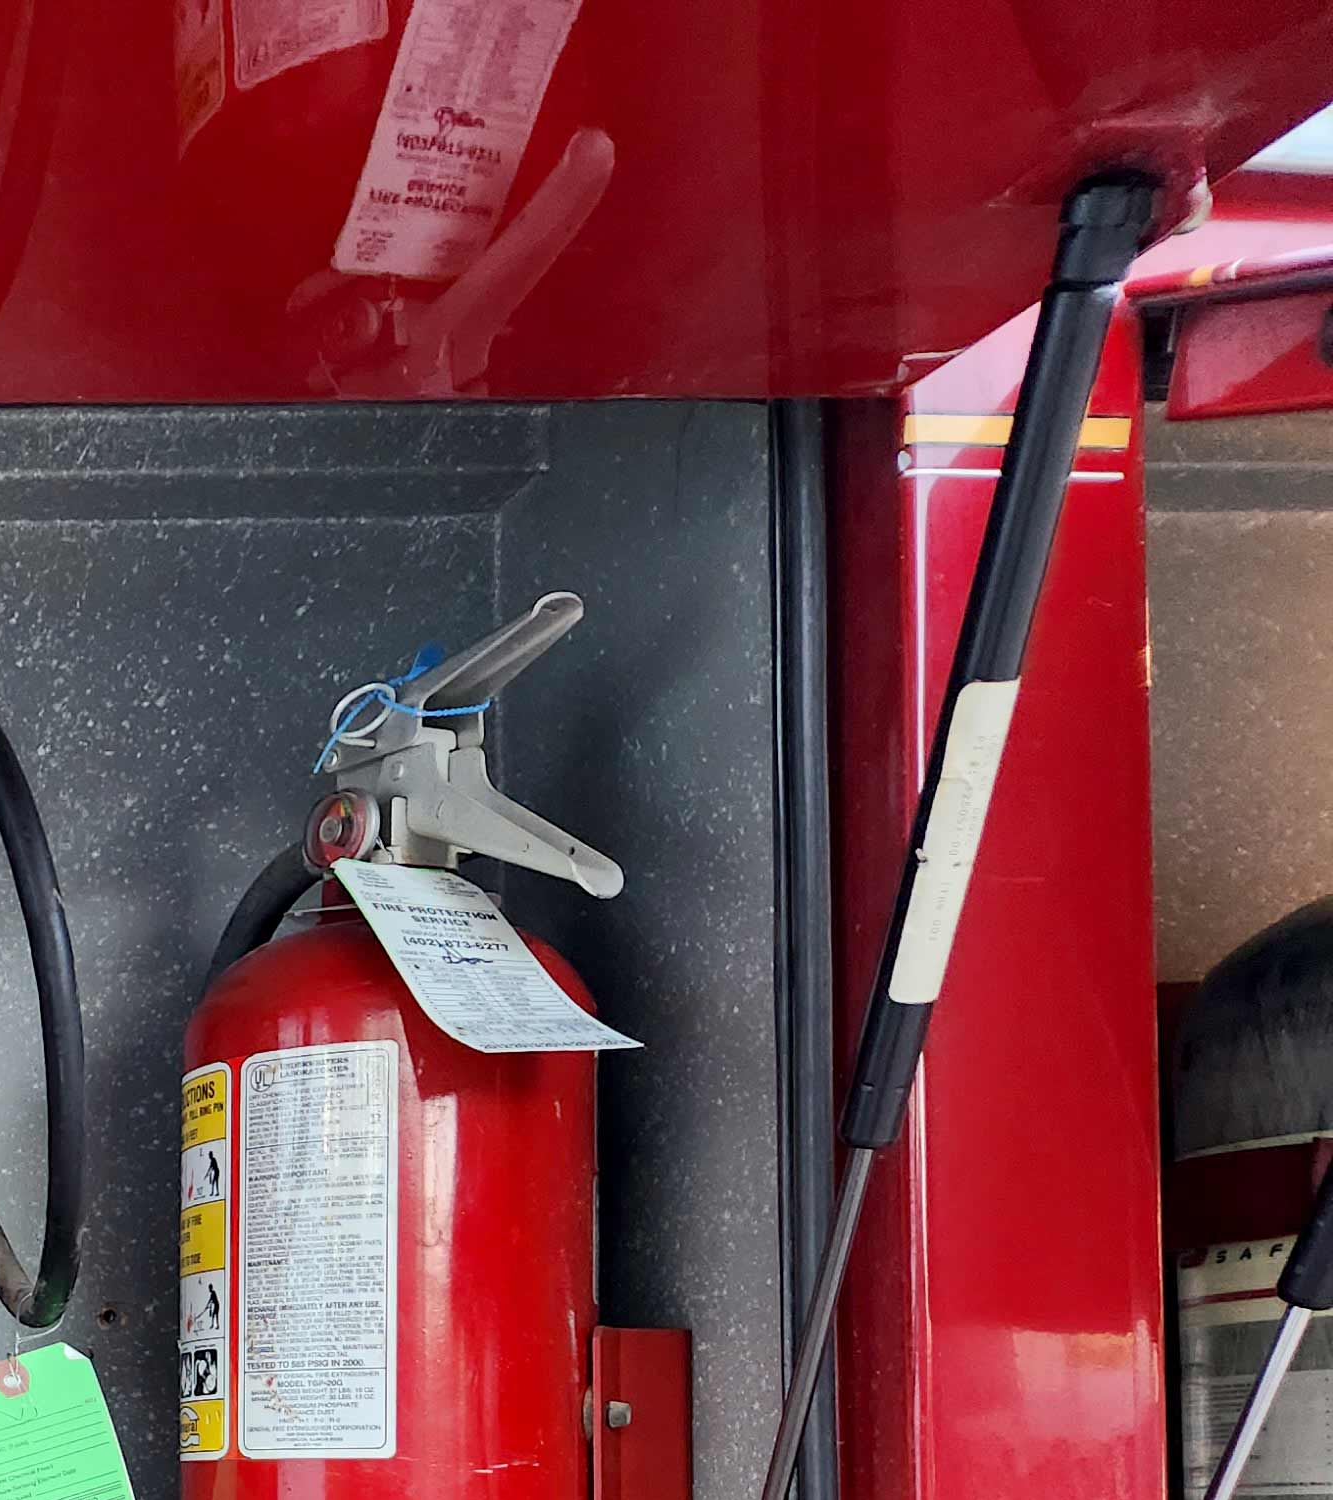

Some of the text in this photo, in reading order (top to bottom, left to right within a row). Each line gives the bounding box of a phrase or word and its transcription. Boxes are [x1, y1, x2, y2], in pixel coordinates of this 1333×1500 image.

[372, 902, 498, 921] FIRE PROTECTION
[411, 915, 472, 928] SERVICE
[247, 1362, 275, 1370] TESTED
